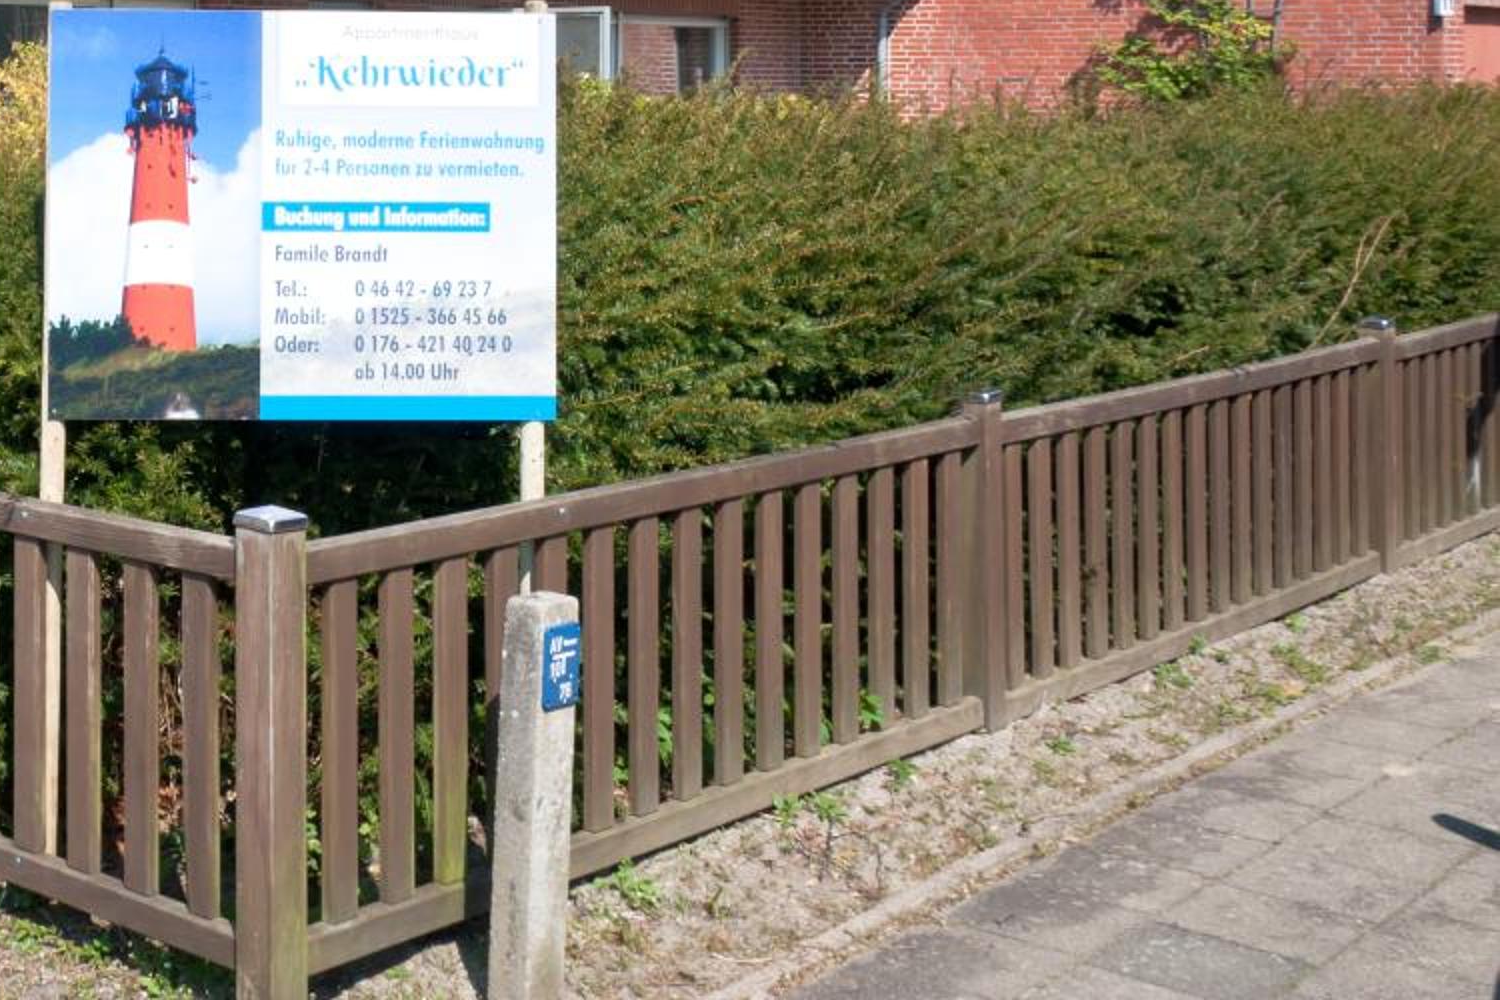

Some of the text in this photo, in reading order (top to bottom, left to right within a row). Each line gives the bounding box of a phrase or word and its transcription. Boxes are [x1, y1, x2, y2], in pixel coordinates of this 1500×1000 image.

[275, 130, 545, 154] Ruhige, moderne Ferienwohnung
[304, 159, 330, 176] 2-4
[336, 159, 409, 177] Personen
[416, 163, 433, 177] zu
[439, 159, 524, 177] vermieten.
[274, 205, 344, 230] Buchung
[348, 205, 380, 225] und
[335, 245, 388, 262] Brandt
[274, 280, 308, 297] Tel.:
[355, 280, 364, 297] 0
[370, 280, 389, 297] 46
[395, 280, 415, 297] 42
[433, 280, 451, 297] 69
[458, 280, 477, 297] 23
[483, 280, 492, 297] 7
[274, 308, 326, 325] Mobil:
[355, 308, 364, 325] 0
[371, 308, 410, 325] 1525
[428, 308, 457, 325] 366
[463, 308, 481, 325] 45
[487, 308, 507, 325] 66
[274, 336, 320, 352] Oder:
[355, 336, 364, 352] 0
[371, 336, 399, 352] 176
[418, 336, 445, 352] 421
[476, 336, 496, 352] 24
[502, 336, 512, 352] 0
[355, 364, 460, 380] ab 14.00 Uhr
